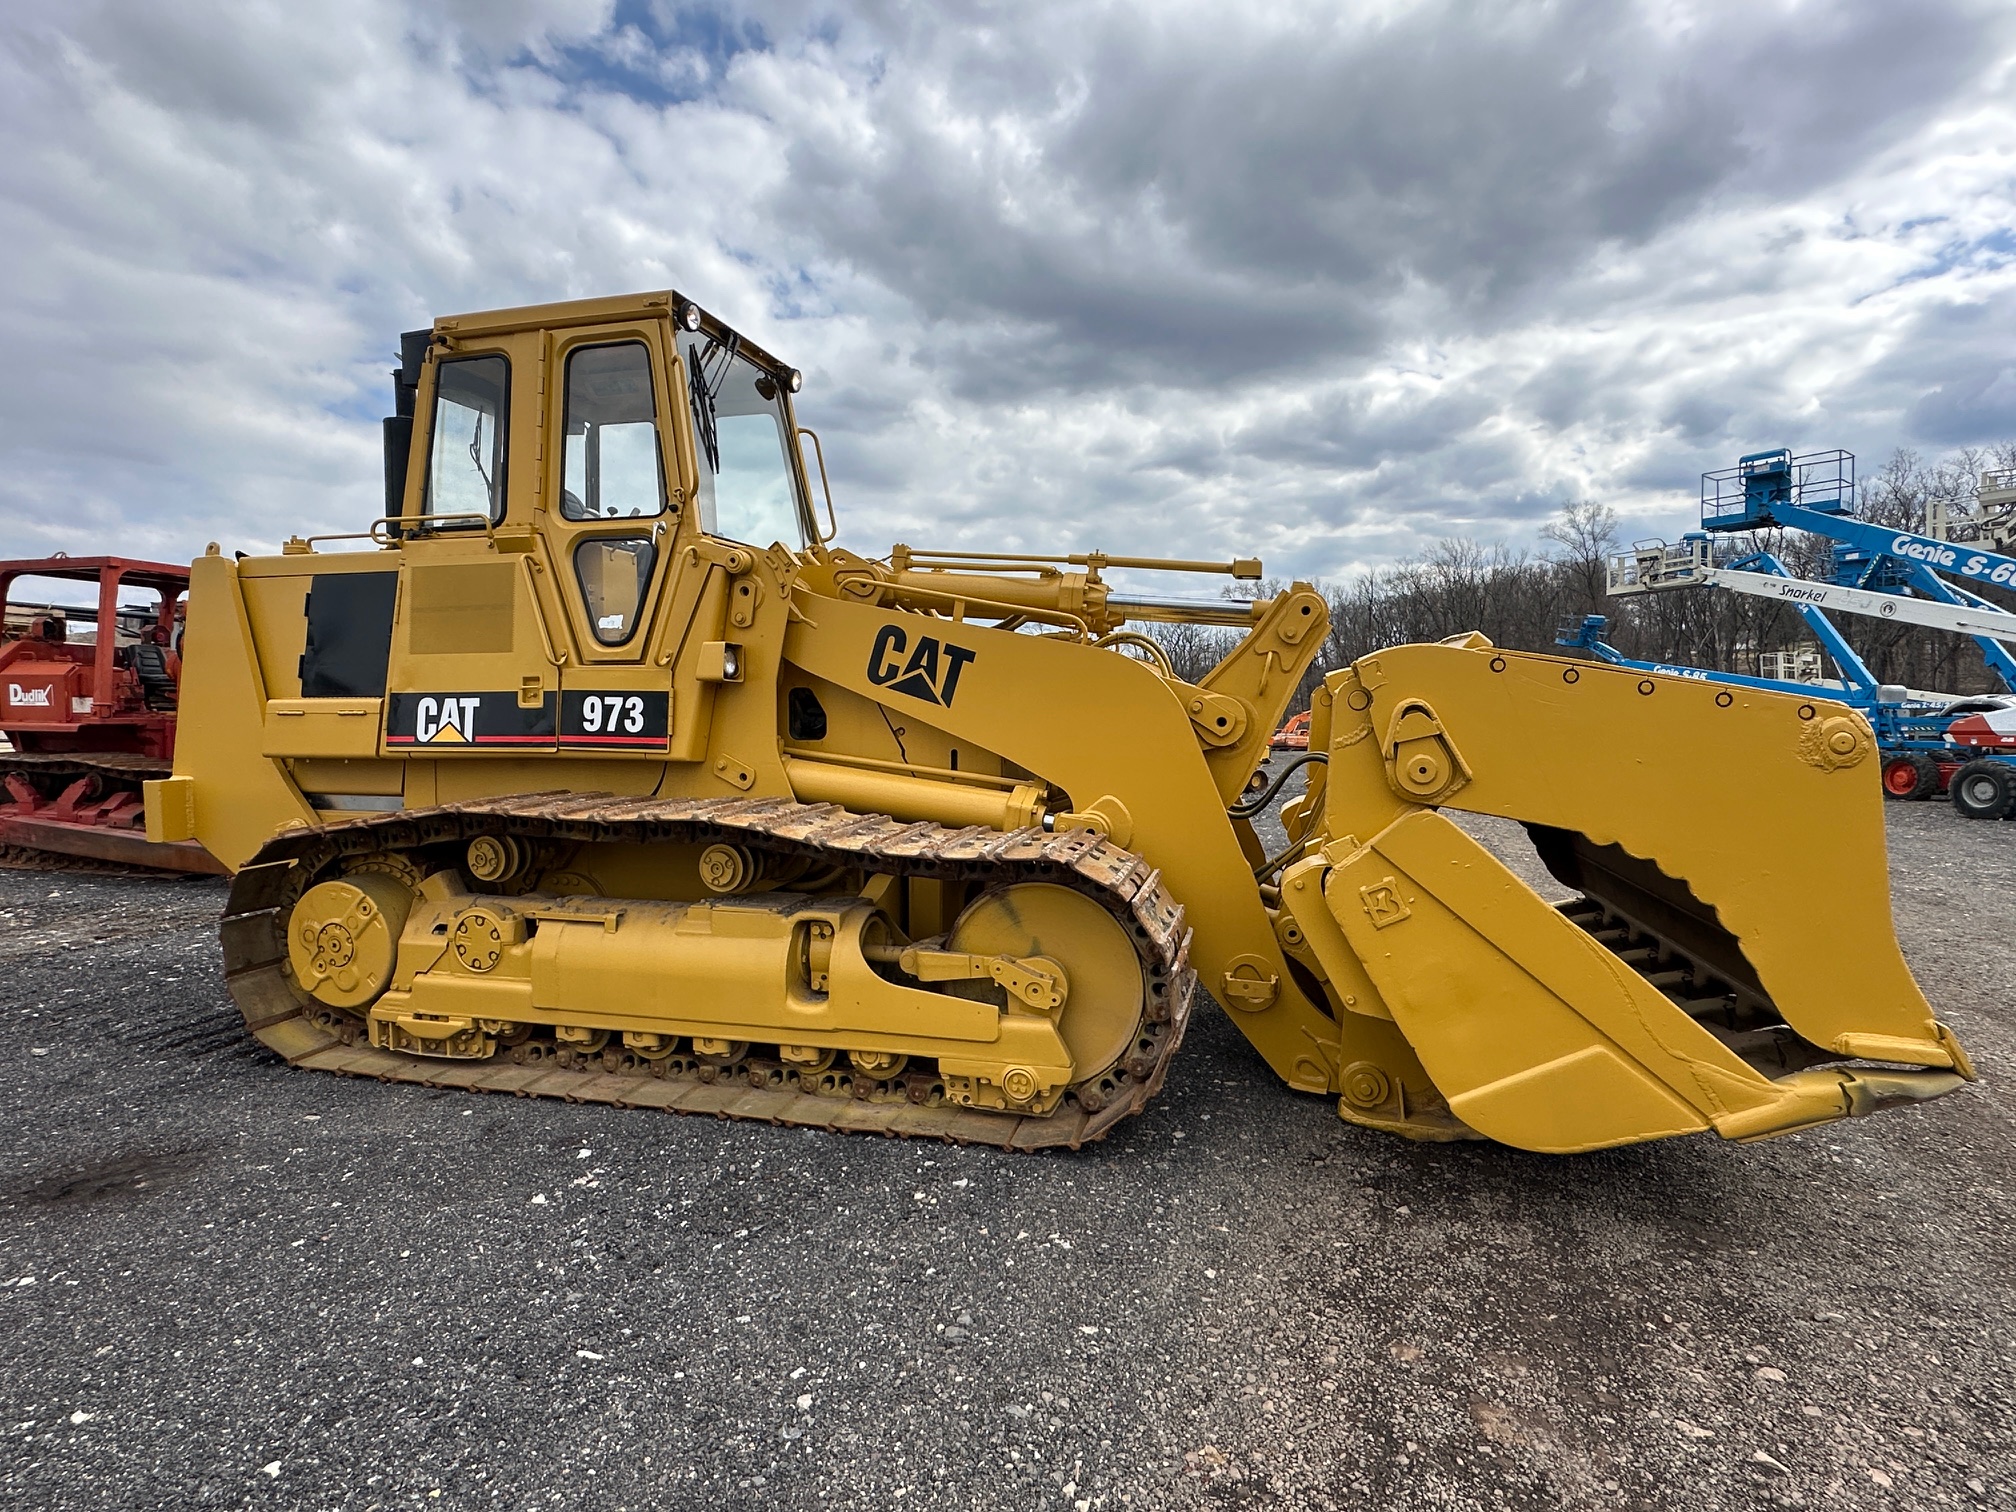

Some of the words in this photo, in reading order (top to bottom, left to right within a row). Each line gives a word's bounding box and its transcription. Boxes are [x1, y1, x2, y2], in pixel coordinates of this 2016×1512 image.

[1891, 535, 1957, 567] Genie
[1779, 584, 1828, 603] Snorkel
[867, 624, 976, 708] CAT
[9, 683, 53, 706] Dudlik
[416, 697, 480, 742] CAT
[582, 696, 645, 733] 973
